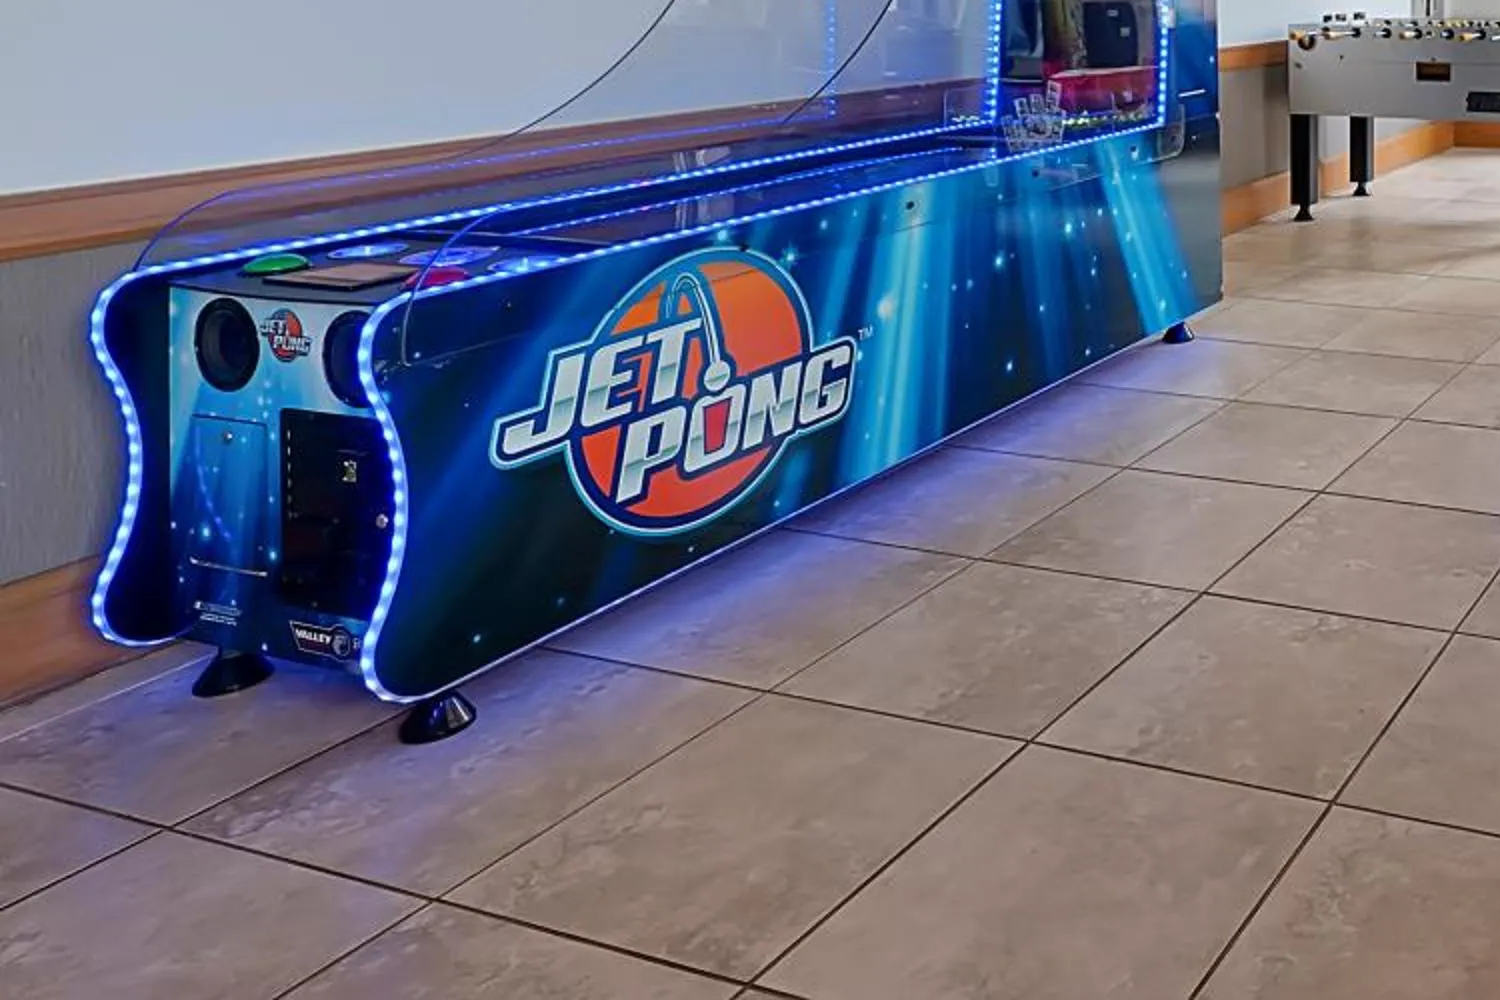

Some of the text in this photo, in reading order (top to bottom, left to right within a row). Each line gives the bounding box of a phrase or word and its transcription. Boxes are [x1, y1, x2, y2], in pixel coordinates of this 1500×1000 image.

[502, 318, 704, 456] JET
[615, 344, 852, 504] PONG
[295, 628, 332, 645] VALLEY
